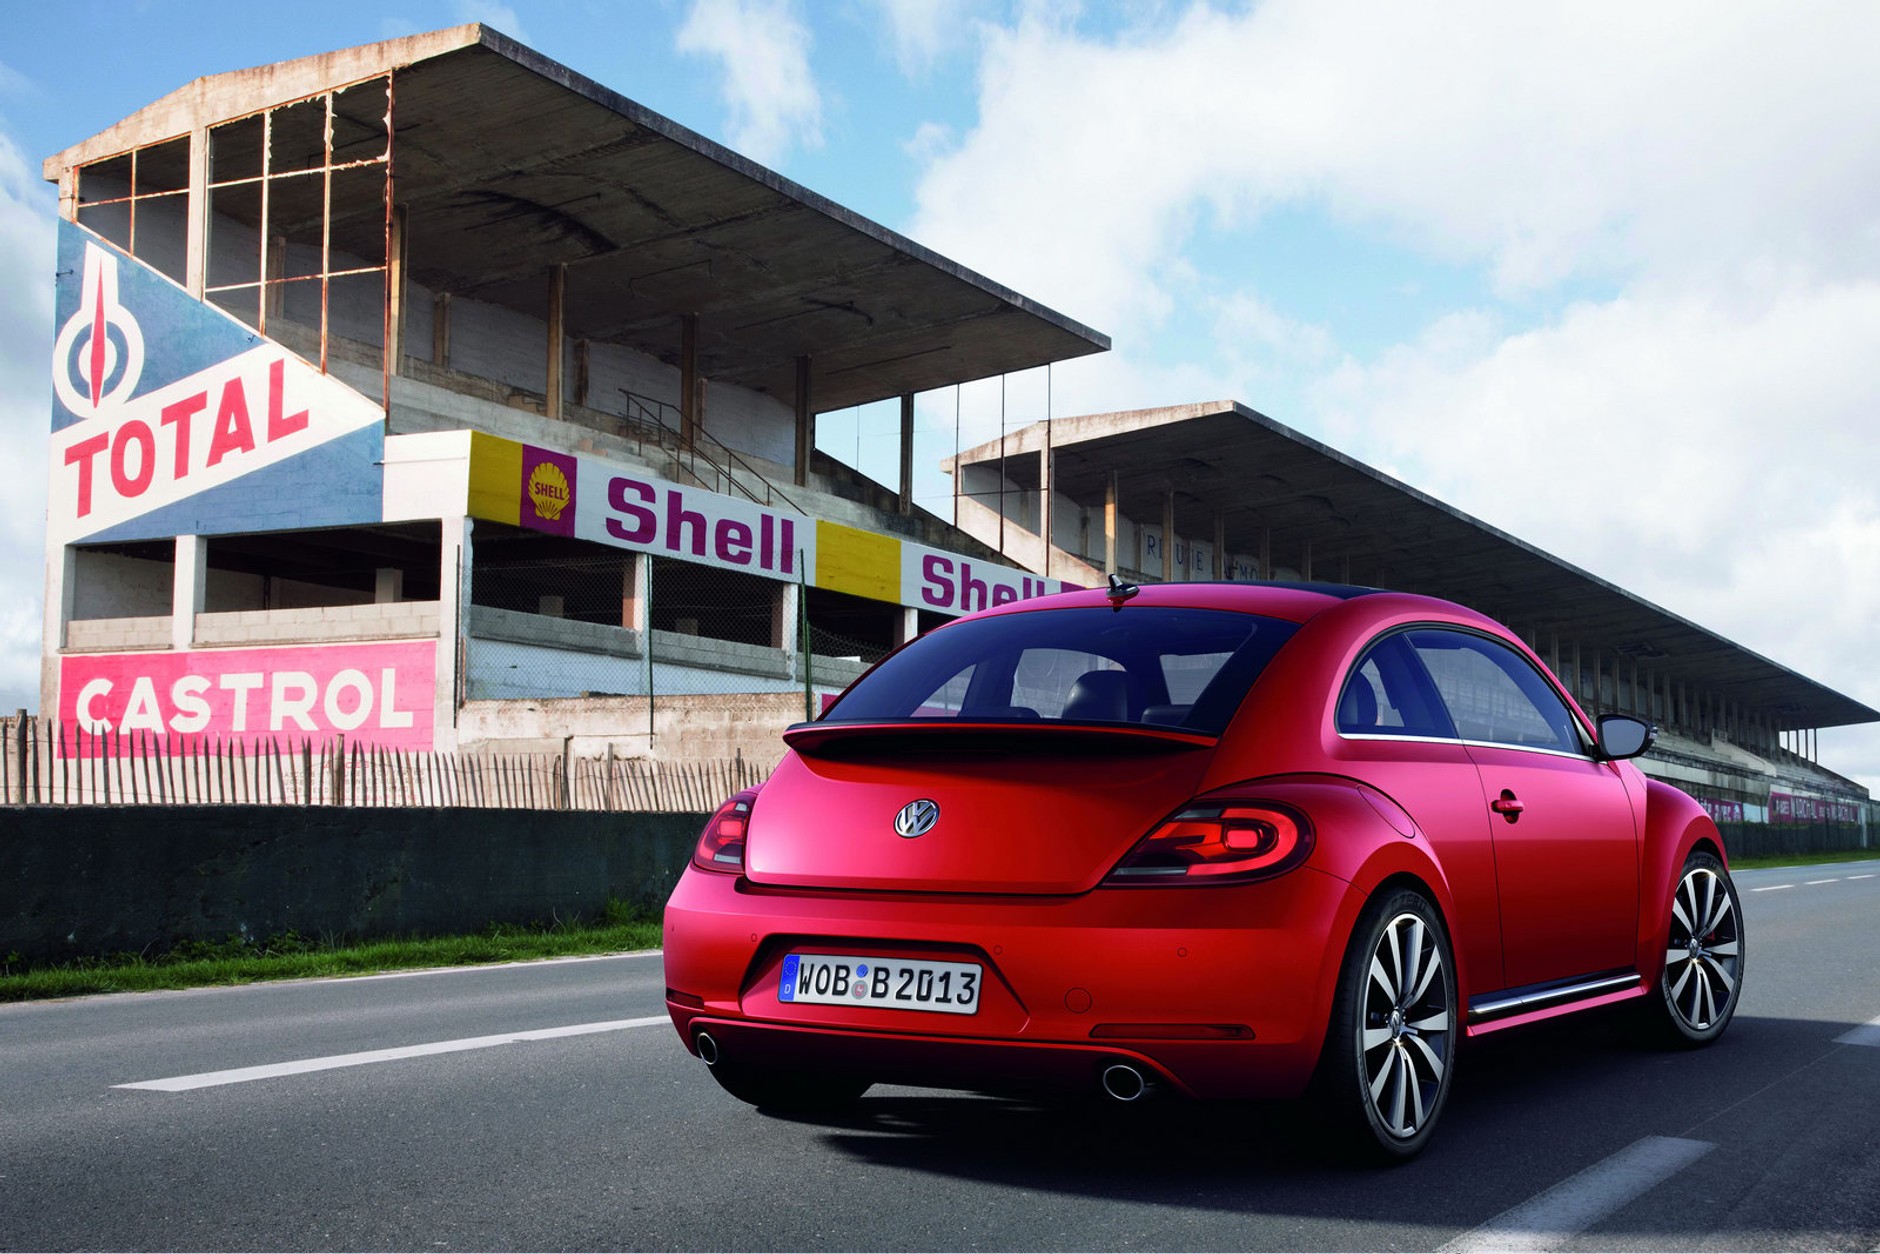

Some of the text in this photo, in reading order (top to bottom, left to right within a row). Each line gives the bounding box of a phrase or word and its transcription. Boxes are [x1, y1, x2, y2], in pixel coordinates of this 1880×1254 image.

[65, 358, 309, 518] TOTAL
[534, 482, 565, 500] SHELL
[606, 476, 794, 575] Shell
[76, 668, 414, 735] CASTROL
[784, 963, 977, 1005] D WOB B 2013
